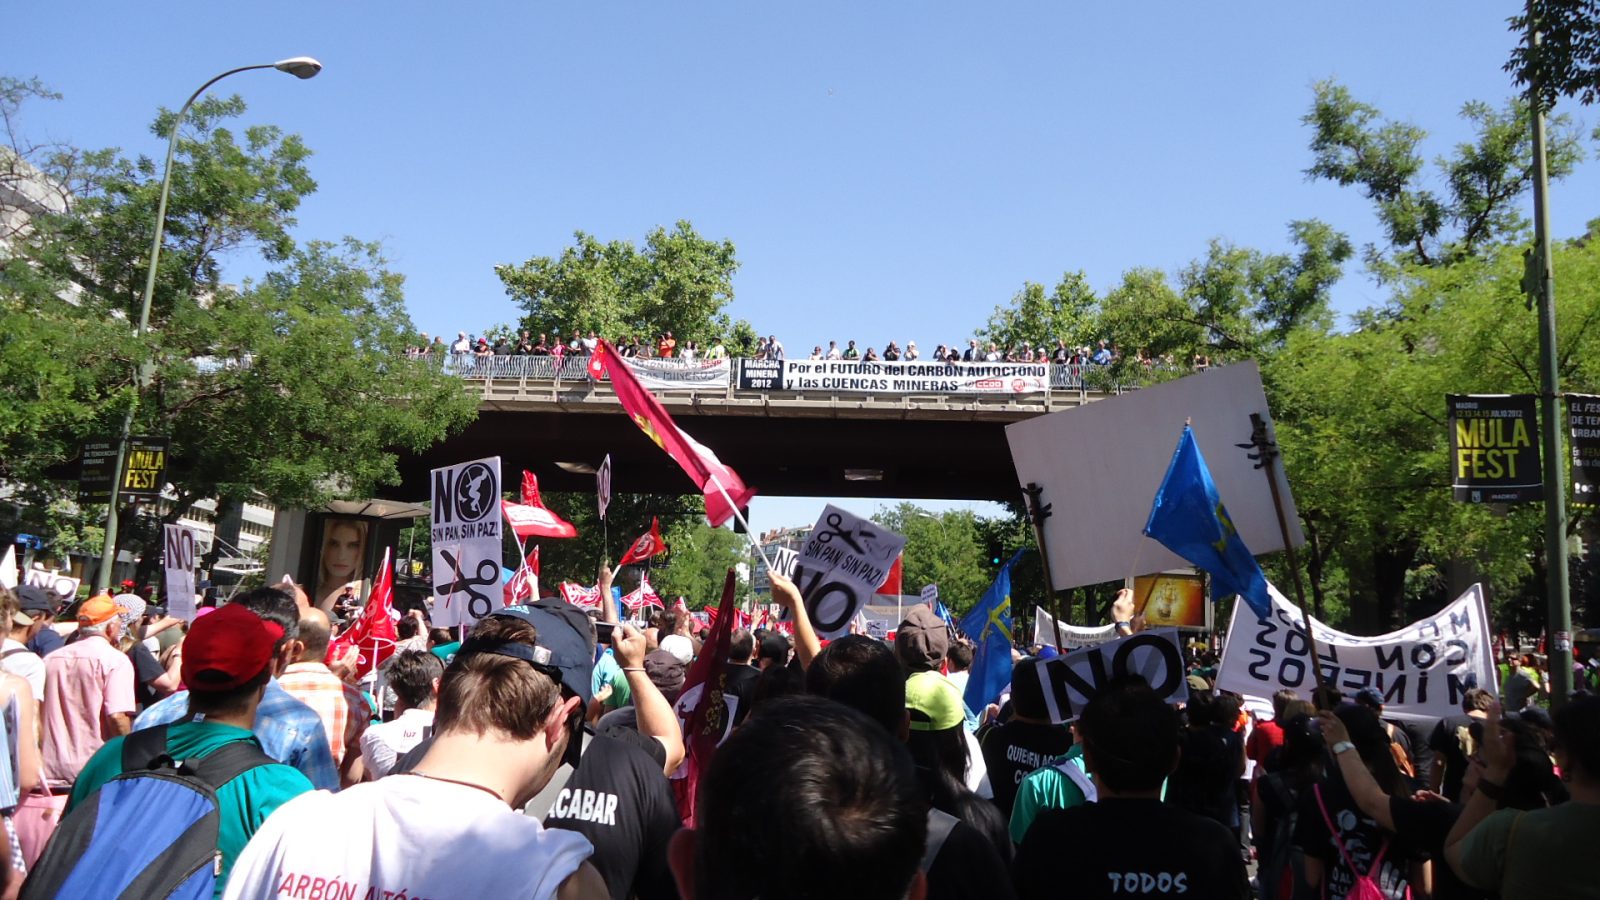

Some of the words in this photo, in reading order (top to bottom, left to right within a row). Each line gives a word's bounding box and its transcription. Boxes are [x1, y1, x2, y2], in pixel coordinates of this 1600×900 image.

[744, 359, 780, 369] MARCHA
[745, 370, 778, 378] MINERA
[788, 363, 811, 373] Por
[815, 363, 826, 373] el
[830, 363, 880, 375] FUTURO
[884, 364, 904, 376] del
[751, 379, 772, 388] 2012
[786, 378, 793, 389] y
[799, 377, 818, 388] las
[822, 378, 888, 390] CUENCAS
[893, 380, 958, 391] MINERAS
[1571, 402, 1582, 412] EL
[1571, 415, 1584, 425] DE
[1456, 418, 1530, 448] MULA
[129, 451, 164, 470] MULA
[1457, 449, 1519, 478] FEST
[125, 470, 158, 488] FEST
[434, 462, 497, 524] NO
[432, 528, 444, 543] SIN
[461, 524, 476, 539] SIN
[477, 521, 498, 538] PAZ!
[166, 527, 194, 572] NO
[804, 540, 822, 558] SIN
[841, 554, 859, 573] SIN
[30, 572, 76, 599] NO
[780, 564, 857, 633] NO
[1046, 634, 1185, 722] NO
[403, 729, 416, 738] luz
[277, 871, 358, 900] ARBÓN
[1107, 872, 1188, 894] TODOS
